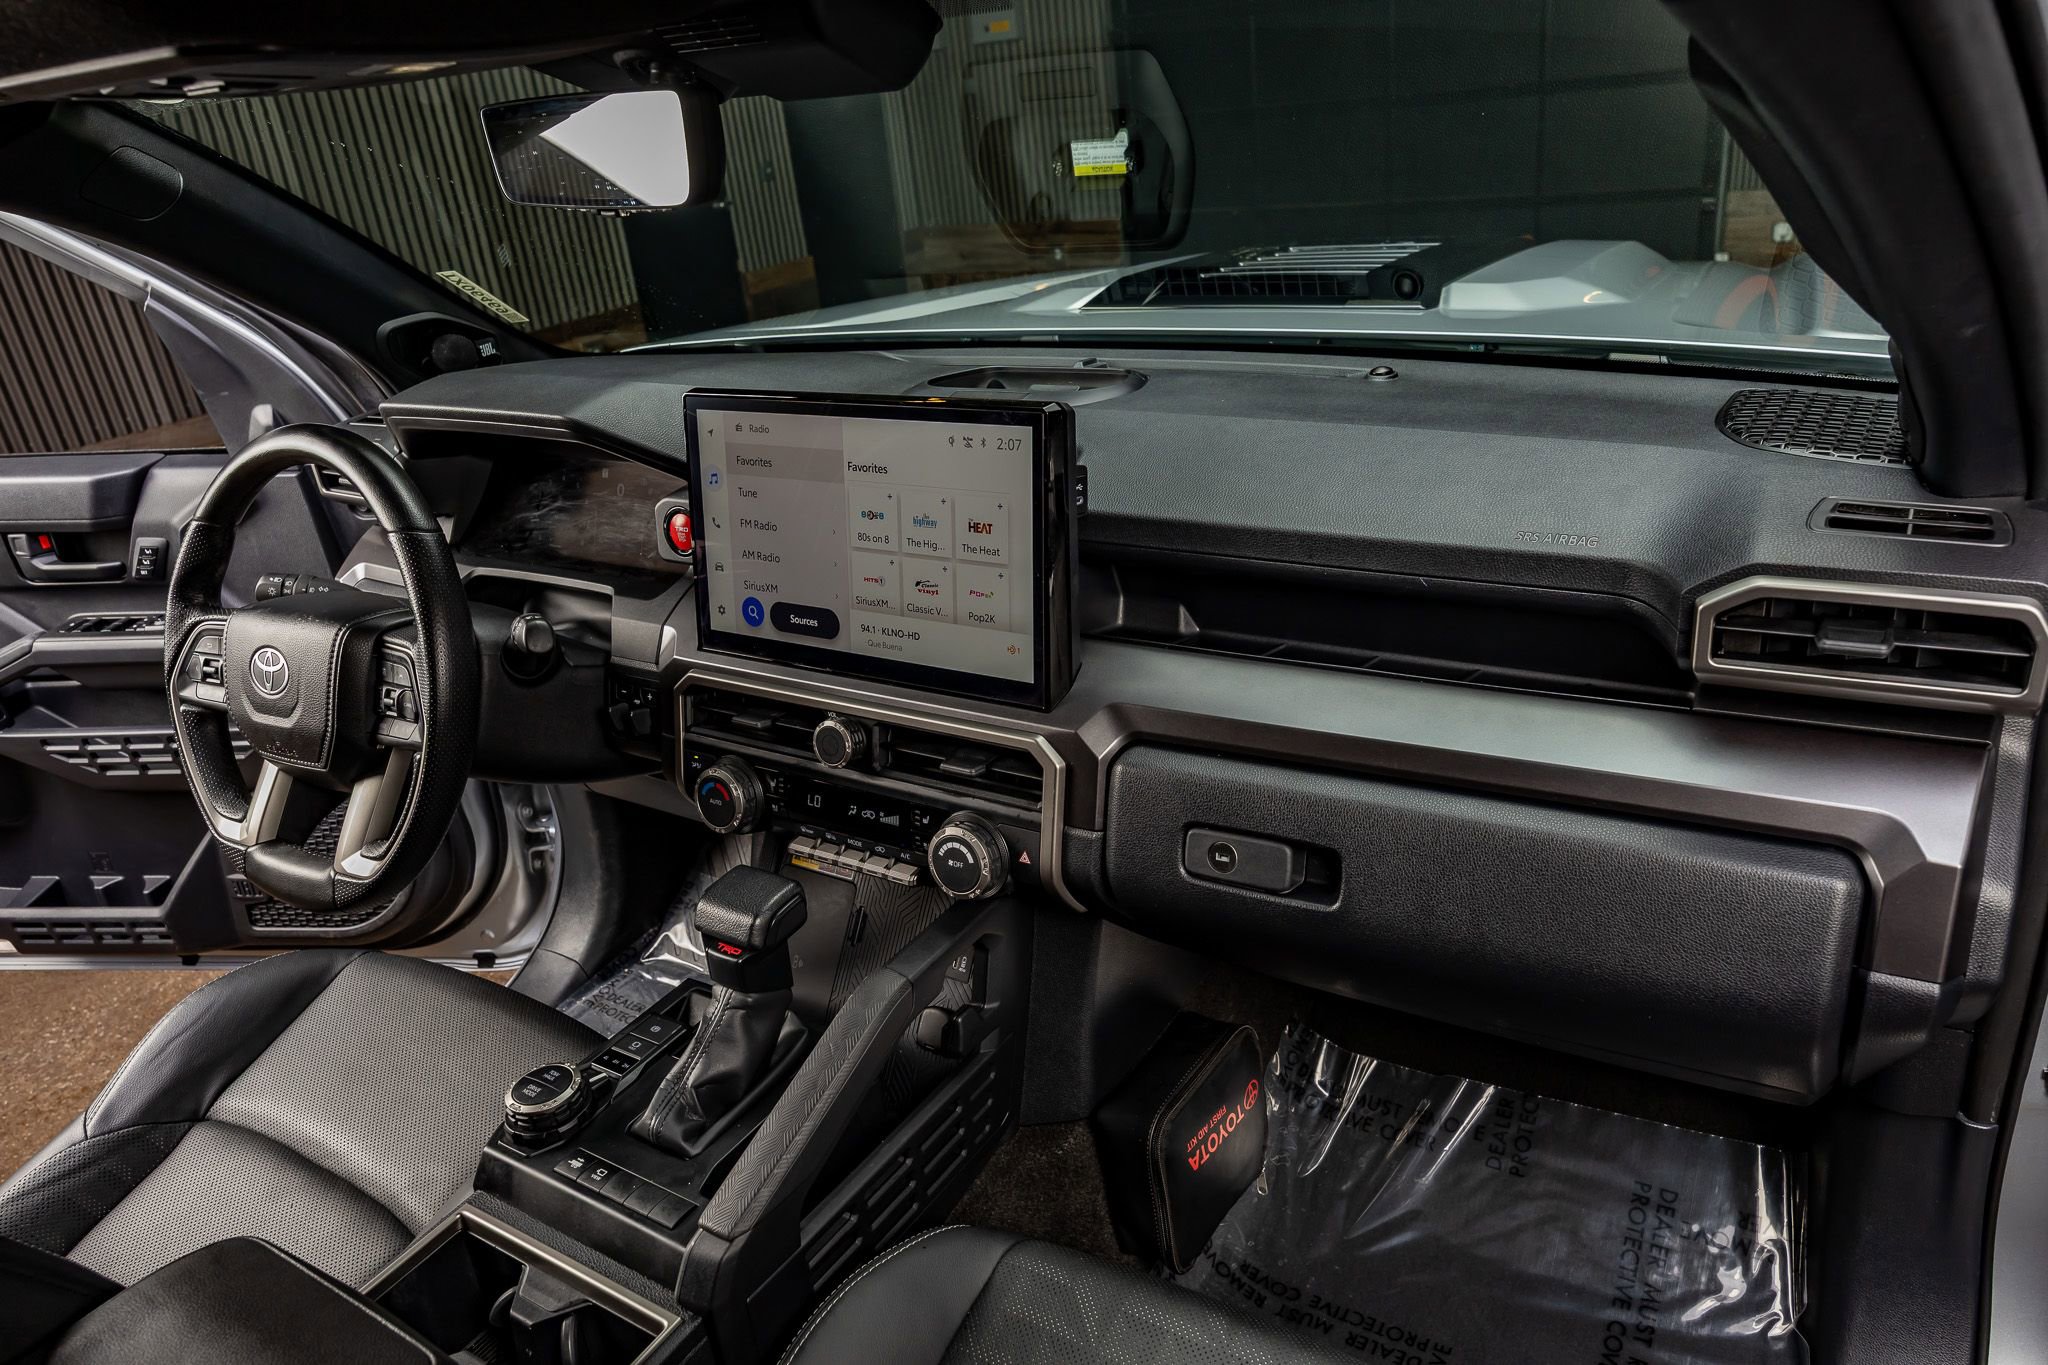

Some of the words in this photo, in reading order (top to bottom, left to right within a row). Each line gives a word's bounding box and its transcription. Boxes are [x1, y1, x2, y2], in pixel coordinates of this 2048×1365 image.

[749, 424, 770, 434] Radio
[996, 437, 1022, 451] 2:07
[736, 455, 773, 468] Favorites
[847, 461, 888, 474] Favorites
[738, 487, 758, 498] Tune
[740, 519, 752, 530] FM
[753, 520, 778, 532] Radio
[968, 521, 993, 535] HEAT
[857, 532, 871, 542] 80s
[872, 536, 883, 544] on
[884, 535, 890, 545] 8
[906, 537, 922, 548] The
[1514, 531, 1540, 543] SRS
[1541, 533, 1599, 548] AIRBAG
[742, 549, 755, 560] AM
[757, 551, 781, 564] Radio
[962, 543, 978, 554] The
[979, 545, 1001, 557] Heat
[743, 579, 779, 594] SiriusXM
[906, 603, 934, 616] Classic
[790, 614, 818, 627] Sources
[968, 612, 996, 624] Pop2K
[860, 623, 876, 634] 94.1
[881, 627, 921, 641] KLNO-HD
[867, 639, 881, 649] Que
[882, 642, 903, 652] Buena
[847, 838, 863, 848] MODE
[900, 852, 911, 860] A/C
[953, 861, 964, 869] OFF
[717, 941, 743, 955] TRD
[608, 991, 646, 1014] DEALER
[1209, 1105, 1227, 1128] FIRST
[1188, 1104, 1245, 1172] TOYOTA
[1197, 1123, 1209, 1140] AID
[1486, 1098, 1514, 1170] DEALER
[1187, 1136, 1198, 1153] KIT
[1647, 1187, 1679, 1272] DEALER
[1611, 1180, 1653, 1311] PROTECTIVE
[1240, 1260, 1300, 1300] COVER
[1275, 1304, 1333, 1334] MUST
[1633, 1282, 1662, 1348] MUST
[1309, 1294, 1430, 1351] PROTECTIVE
